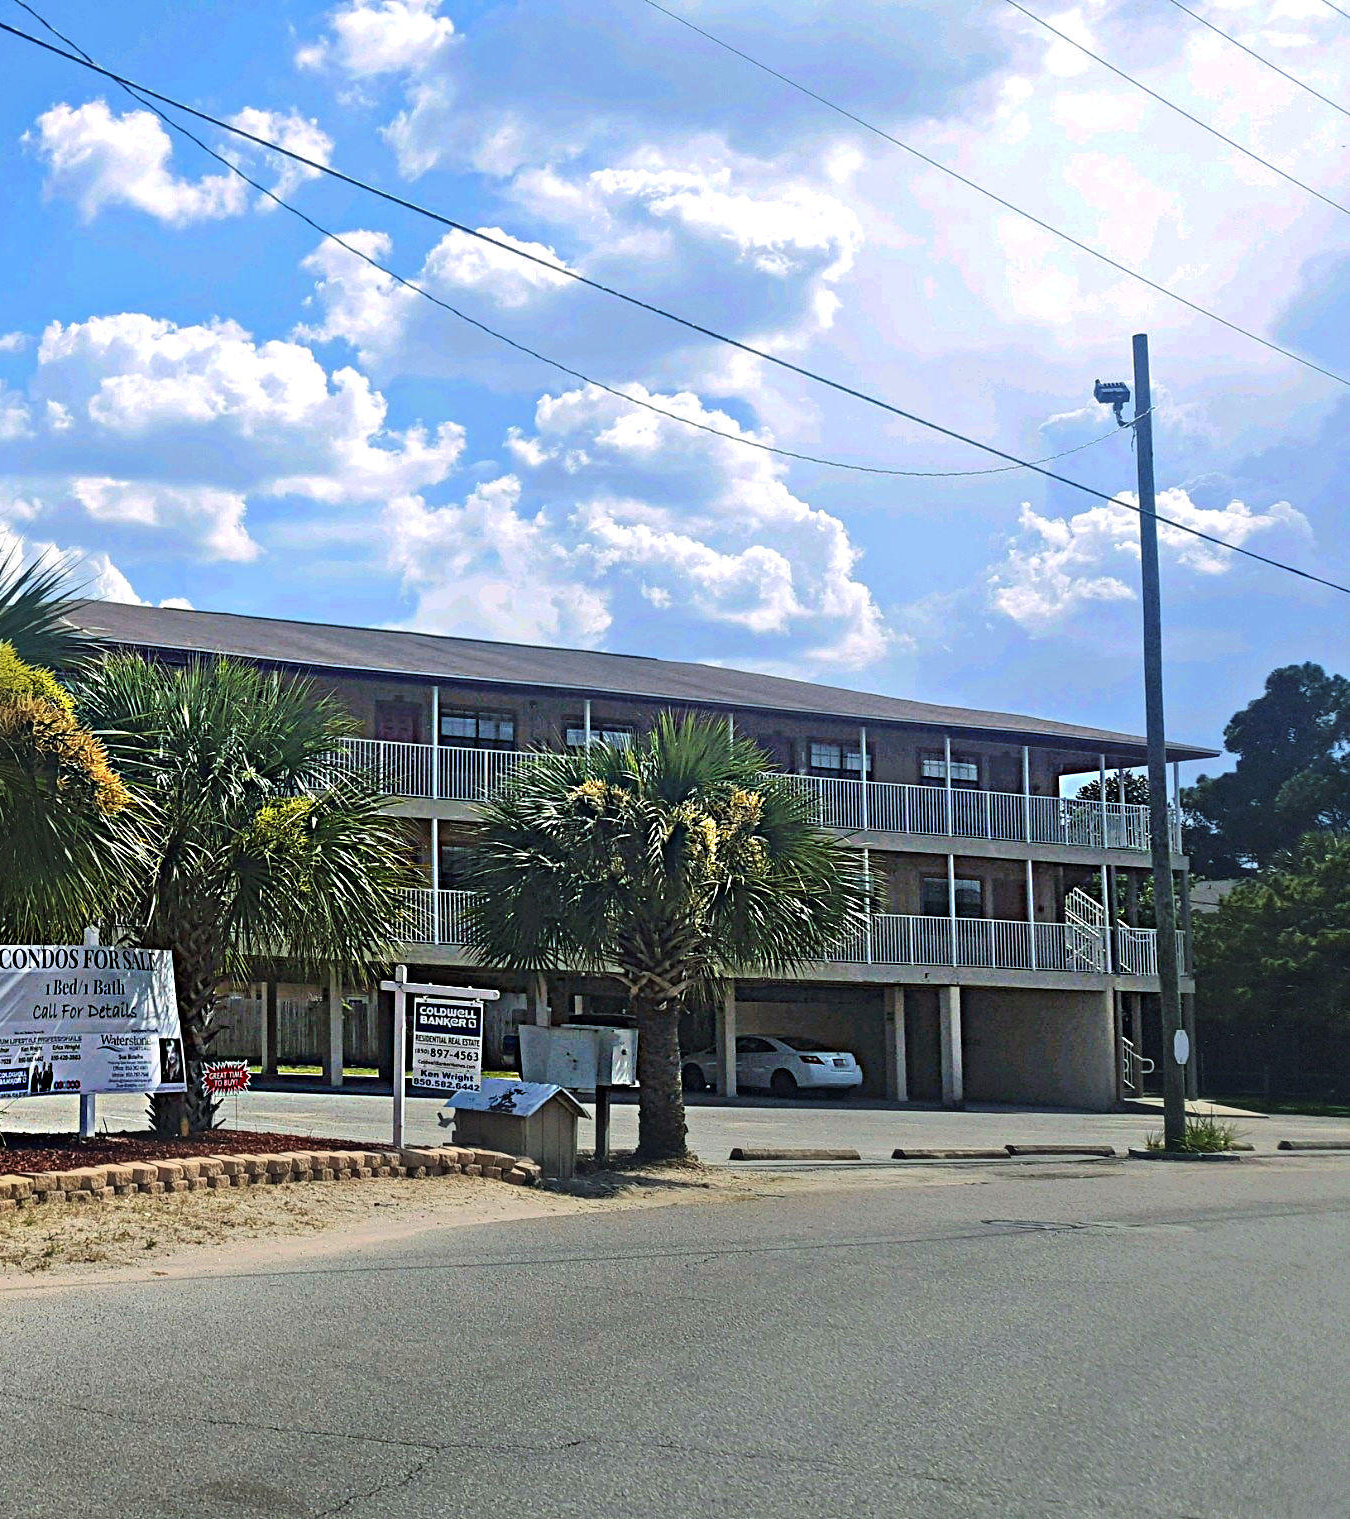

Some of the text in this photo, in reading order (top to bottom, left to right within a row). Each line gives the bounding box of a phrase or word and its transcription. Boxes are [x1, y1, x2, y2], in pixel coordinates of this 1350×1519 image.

[83, 949, 121, 970] FOR
[123, 950, 157, 971] SALE
[45, 978, 126, 996] 1 Bed/1 Bath
[32, 1001, 138, 1020] Call For Details
[100, 1034, 151, 1046] Waterstone
[415, 1034, 480, 1047] RESIDENTIAL REAL ESTATE
[430, 1048, 479, 1062] 897-4563
[208, 1070, 243, 1080] GREAT TIME
[420, 1069, 474, 1082] Ken Wright
[214, 1079, 222, 1087] TO
[413, 1077, 480, 1092] 850.582.6442
